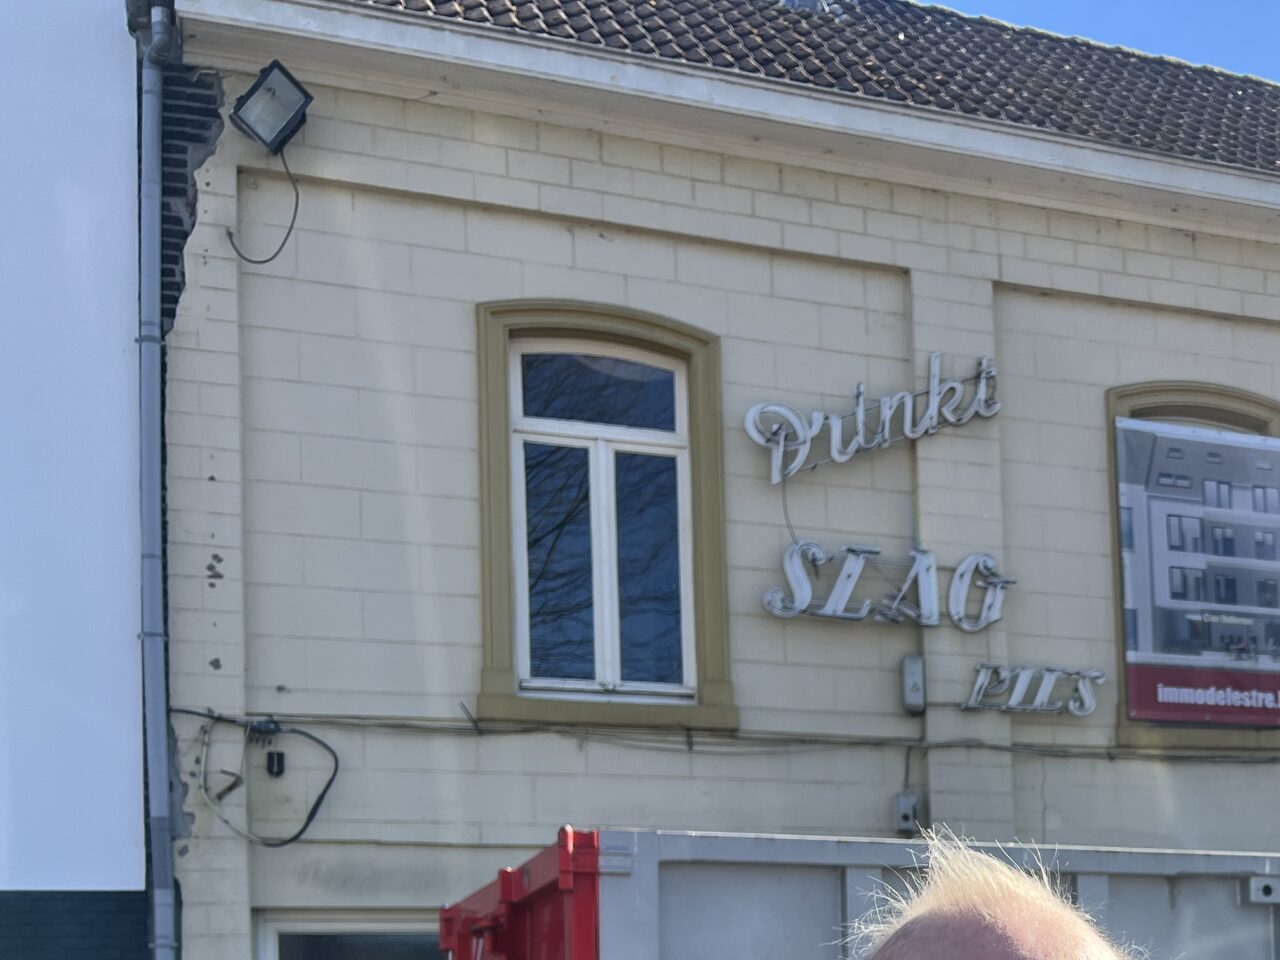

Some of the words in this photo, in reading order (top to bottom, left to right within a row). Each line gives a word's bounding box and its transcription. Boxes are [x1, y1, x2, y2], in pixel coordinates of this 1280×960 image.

[744, 352, 1001, 486] Drinkt
[763, 540, 1017, 633] SLAG
[960, 662, 1105, 717] PILS
